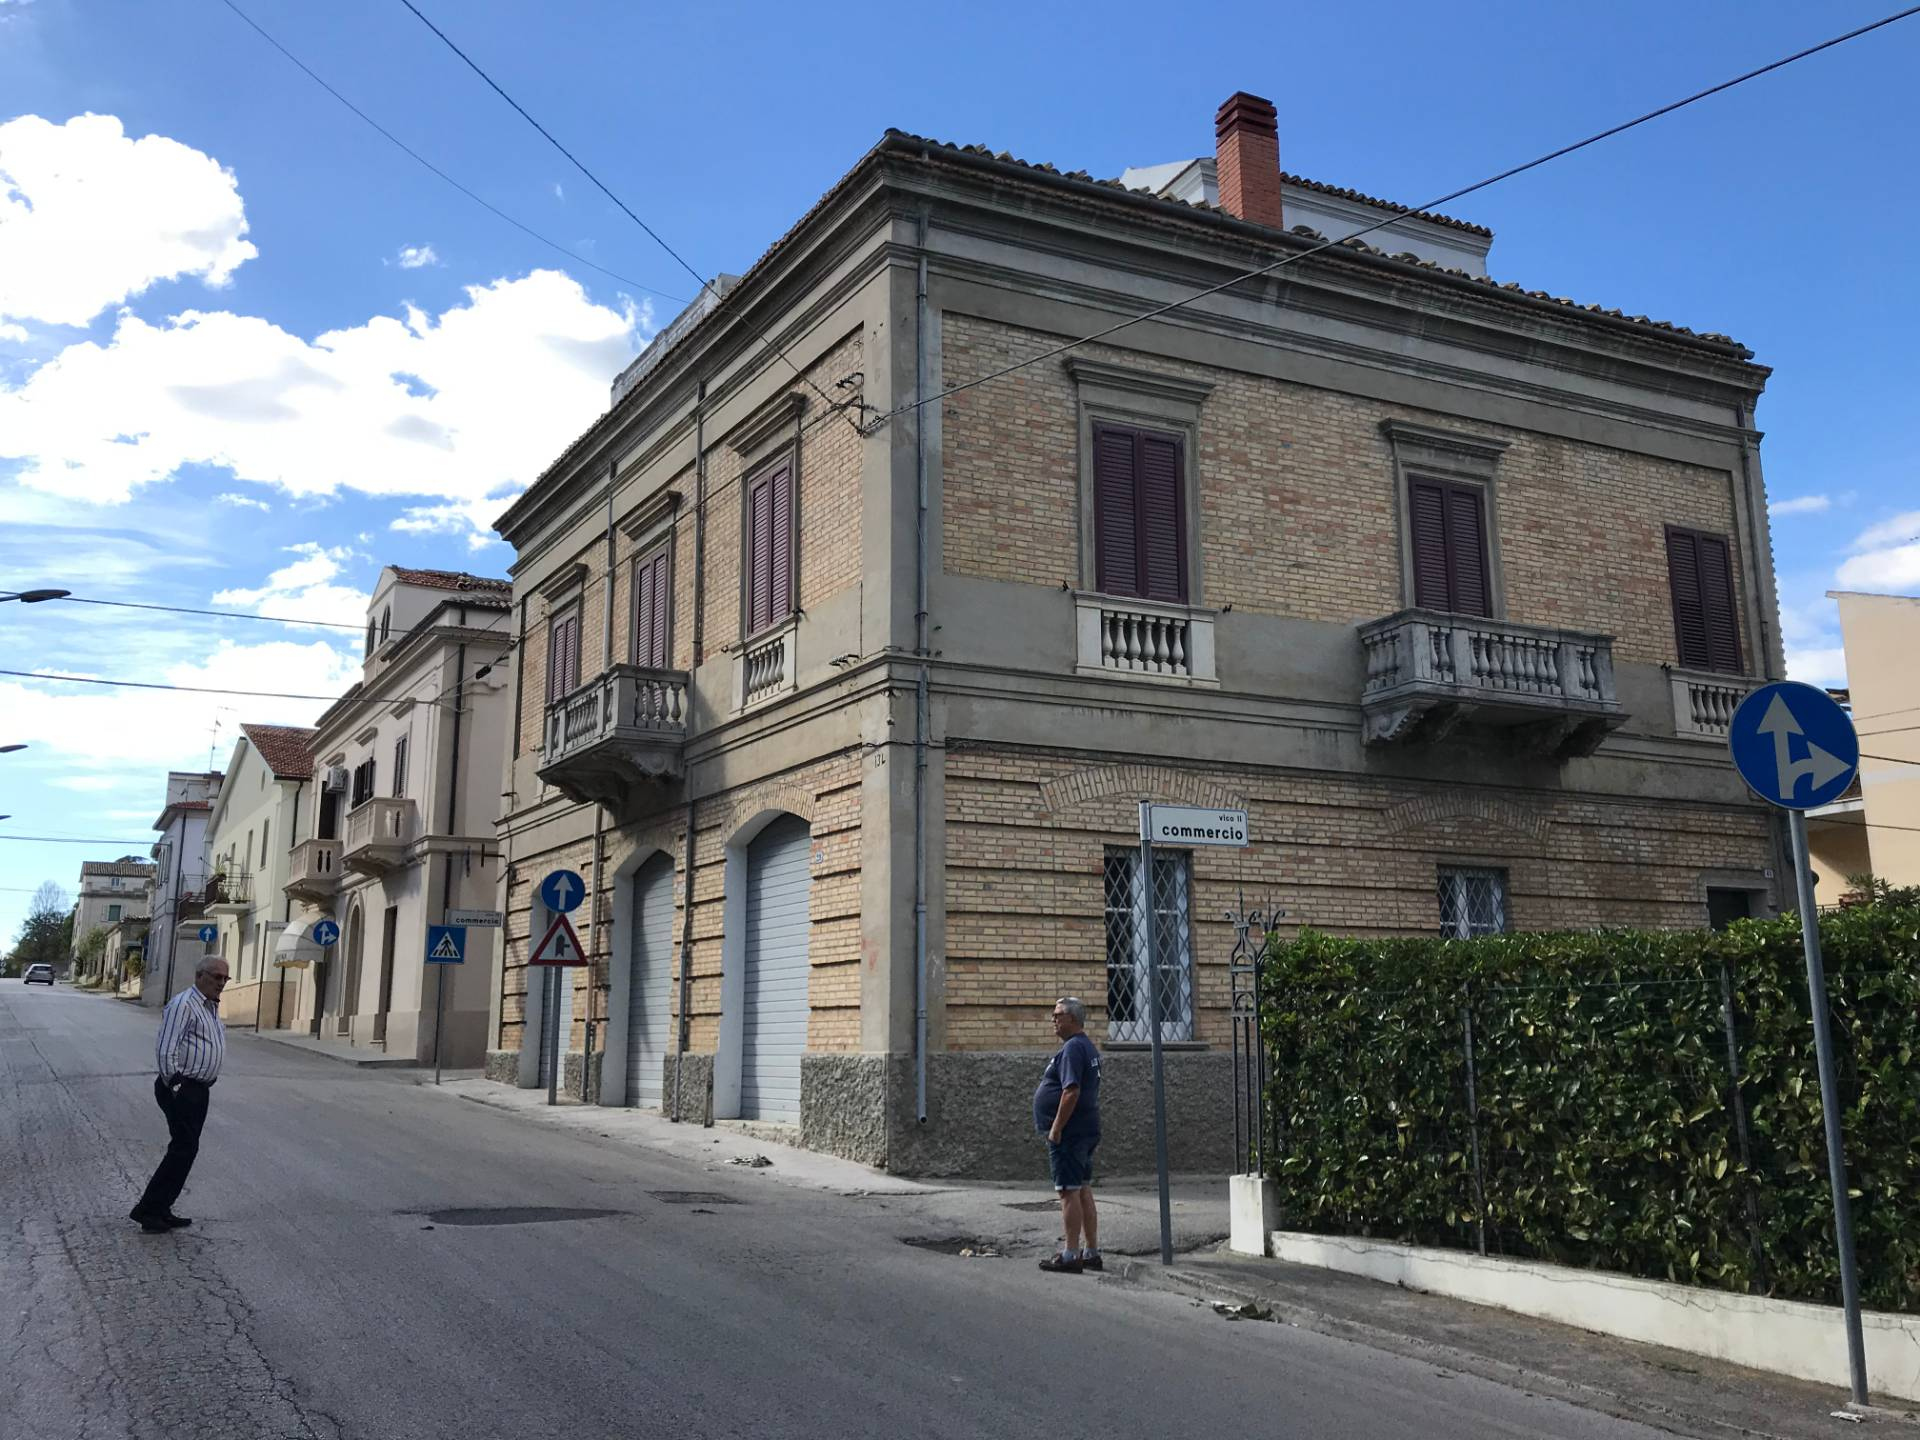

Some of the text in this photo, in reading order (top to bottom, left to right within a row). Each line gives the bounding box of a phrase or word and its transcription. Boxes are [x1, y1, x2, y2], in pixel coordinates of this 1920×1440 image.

[1218, 814, 1235, 822] vico
[1162, 826, 1243, 840] commercio
[455, 917, 500, 925] commercio
